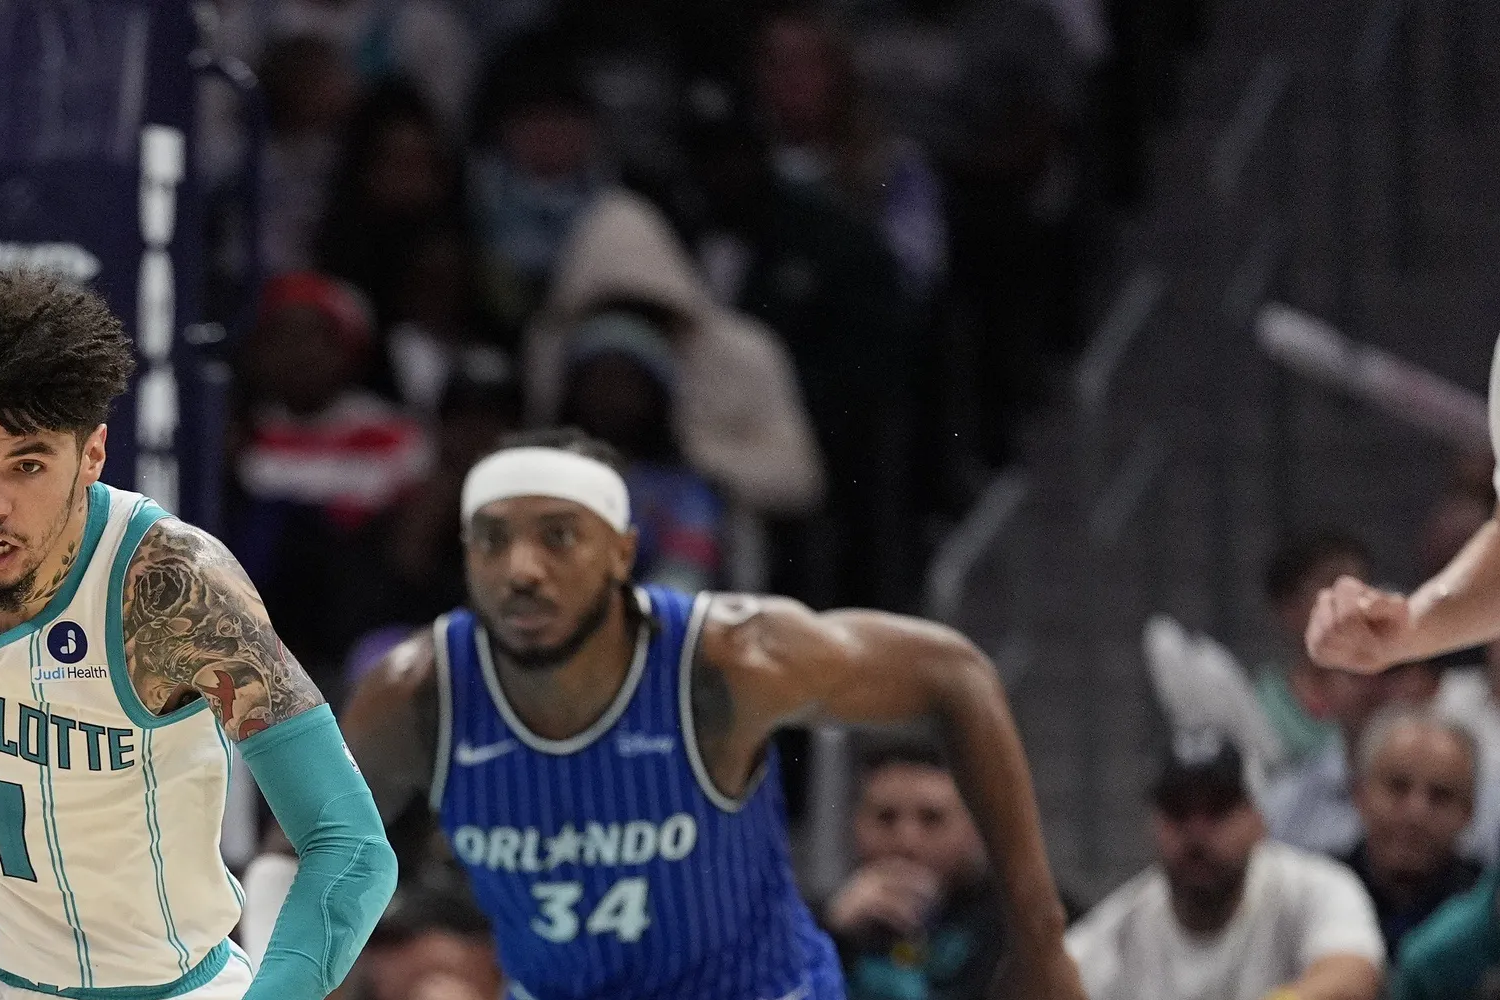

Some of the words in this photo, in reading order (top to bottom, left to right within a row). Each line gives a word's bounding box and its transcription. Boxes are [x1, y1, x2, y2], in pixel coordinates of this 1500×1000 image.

[34, 667, 65, 681] Judi
[67, 666, 107, 679] Health
[529, 876, 652, 943] 34
